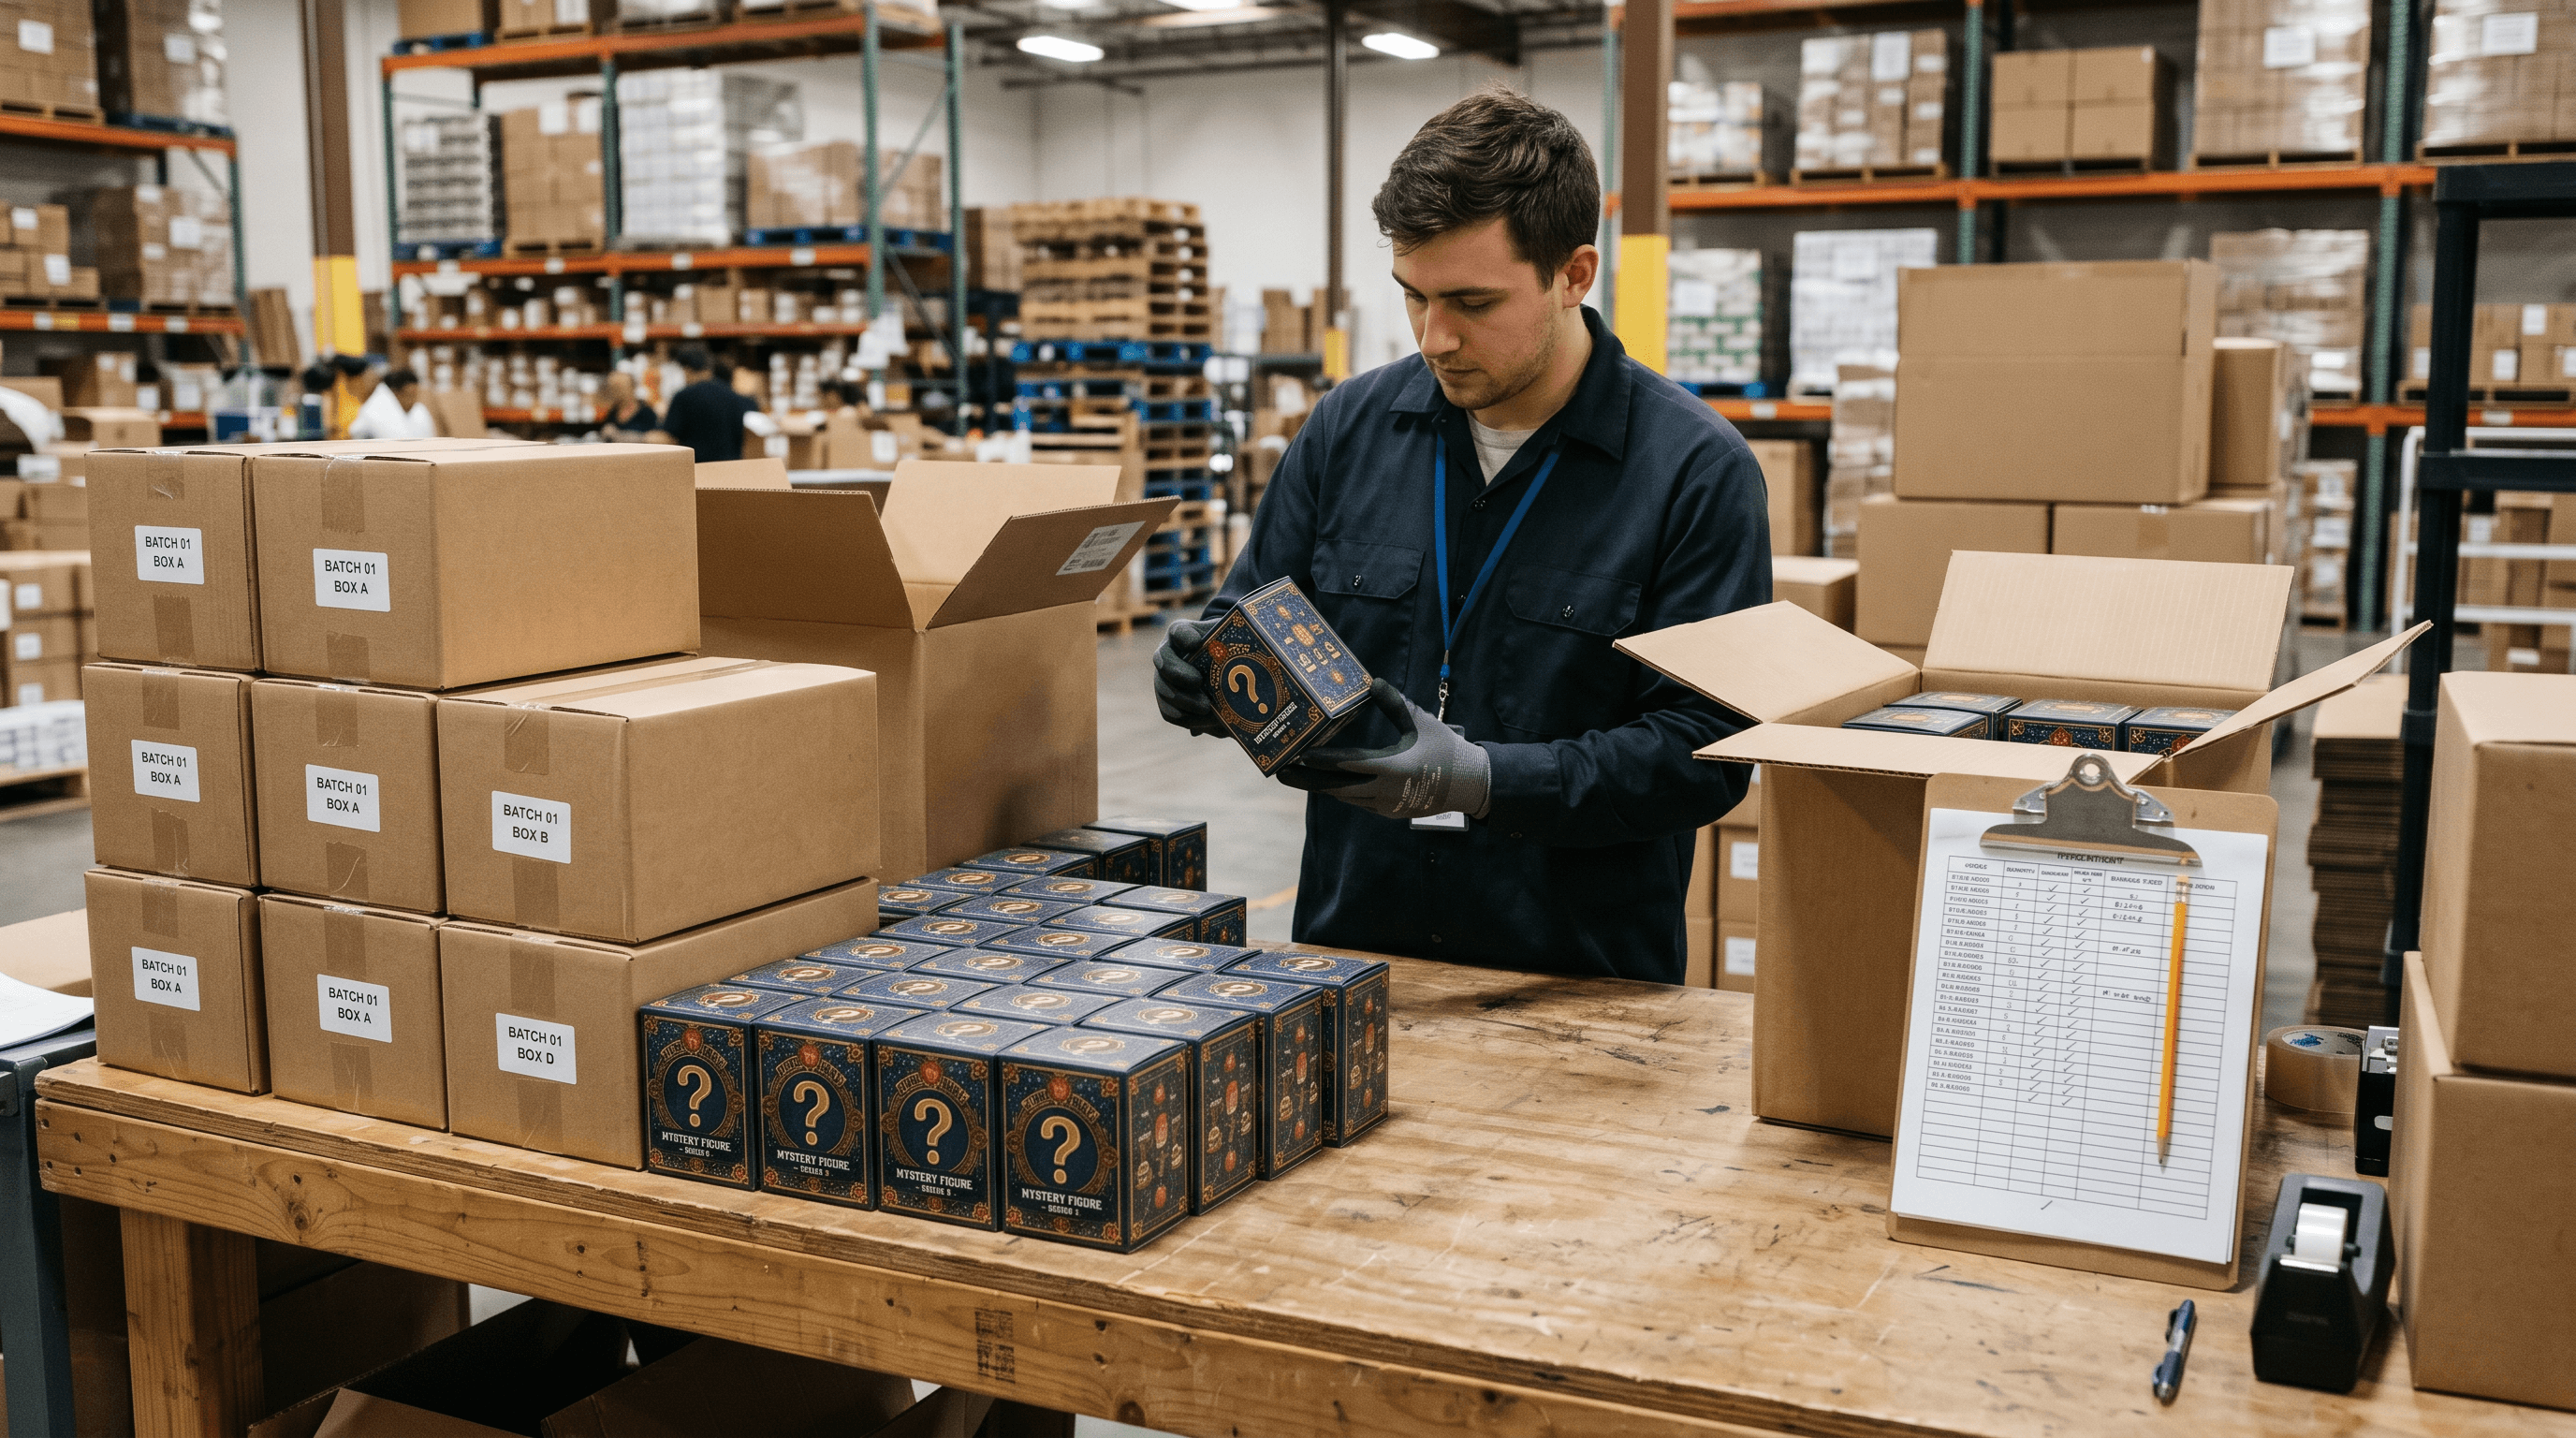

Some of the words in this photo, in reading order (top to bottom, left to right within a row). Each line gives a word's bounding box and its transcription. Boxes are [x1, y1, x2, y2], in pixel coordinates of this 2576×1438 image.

[146, 536, 177, 550] BATCH
[181, 537, 190, 550] 01
[154, 555, 174, 568] BOX
[178, 557, 184, 569] A
[325, 559, 360, 574] BATCH
[364, 562, 375, 575] 01
[334, 580, 358, 594] BOX
[360, 582, 369, 594] A
[141, 751, 173, 767] BATCH
[177, 756, 187, 768] 01
[151, 770, 171, 785] BOX
[174, 774, 182, 785] A
[316, 776, 353, 794] BATCH
[356, 783, 367, 796] 01
[327, 797, 349, 813] BOX
[352, 801, 360, 814] A
[504, 803, 542, 822] BATCH
[546, 812, 558, 825] 01
[512, 826, 537, 842] BOX
[540, 830, 549, 844] B
[141, 959, 173, 975] BATCH
[177, 964, 187, 976] 01
[151, 977, 172, 992] BOX
[175, 982, 183, 993] A
[329, 987, 364, 1004] BATCH
[367, 993, 378, 1006] 01
[337, 1006, 361, 1022] BOX
[364, 1012, 372, 1024] A
[508, 1026, 547, 1044] BATCH
[549, 1034, 562, 1048] 01
[517, 1047, 543, 1063] BOX
[546, 1052, 554, 1064] D
[776, 1149, 817, 1165] MYSTERY
[896, 1167, 938, 1184] MYSTERY
[940, 1175, 973, 1191] FIGURE
